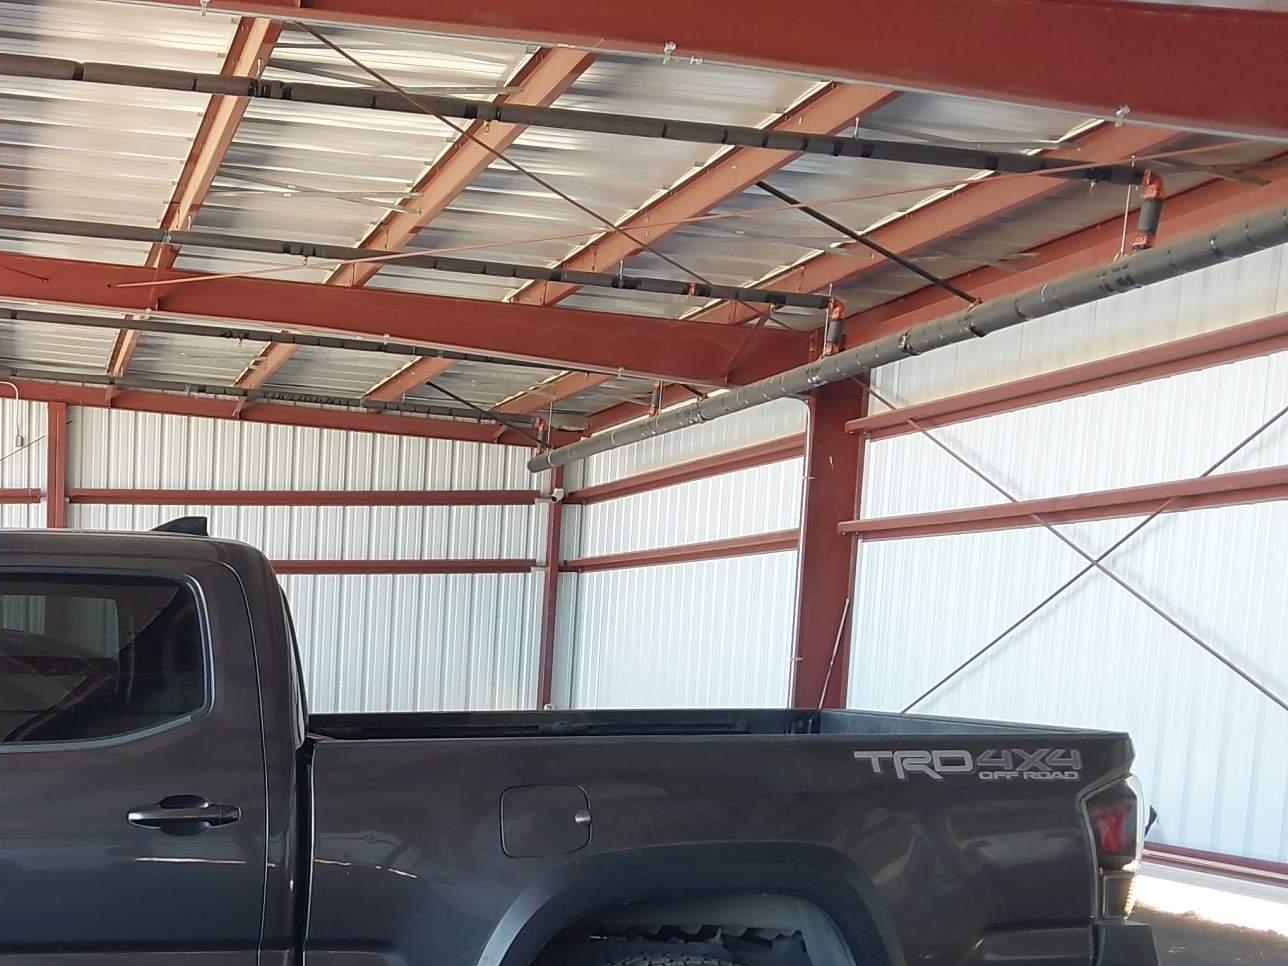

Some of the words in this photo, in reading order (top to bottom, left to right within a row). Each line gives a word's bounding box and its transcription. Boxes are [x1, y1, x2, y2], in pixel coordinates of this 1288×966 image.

[853, 750, 974, 780] TRD
[976, 749, 1083, 771] 4X4
[978, 771, 1019, 780] OFF
[1023, 771, 1080, 780] ROAD
